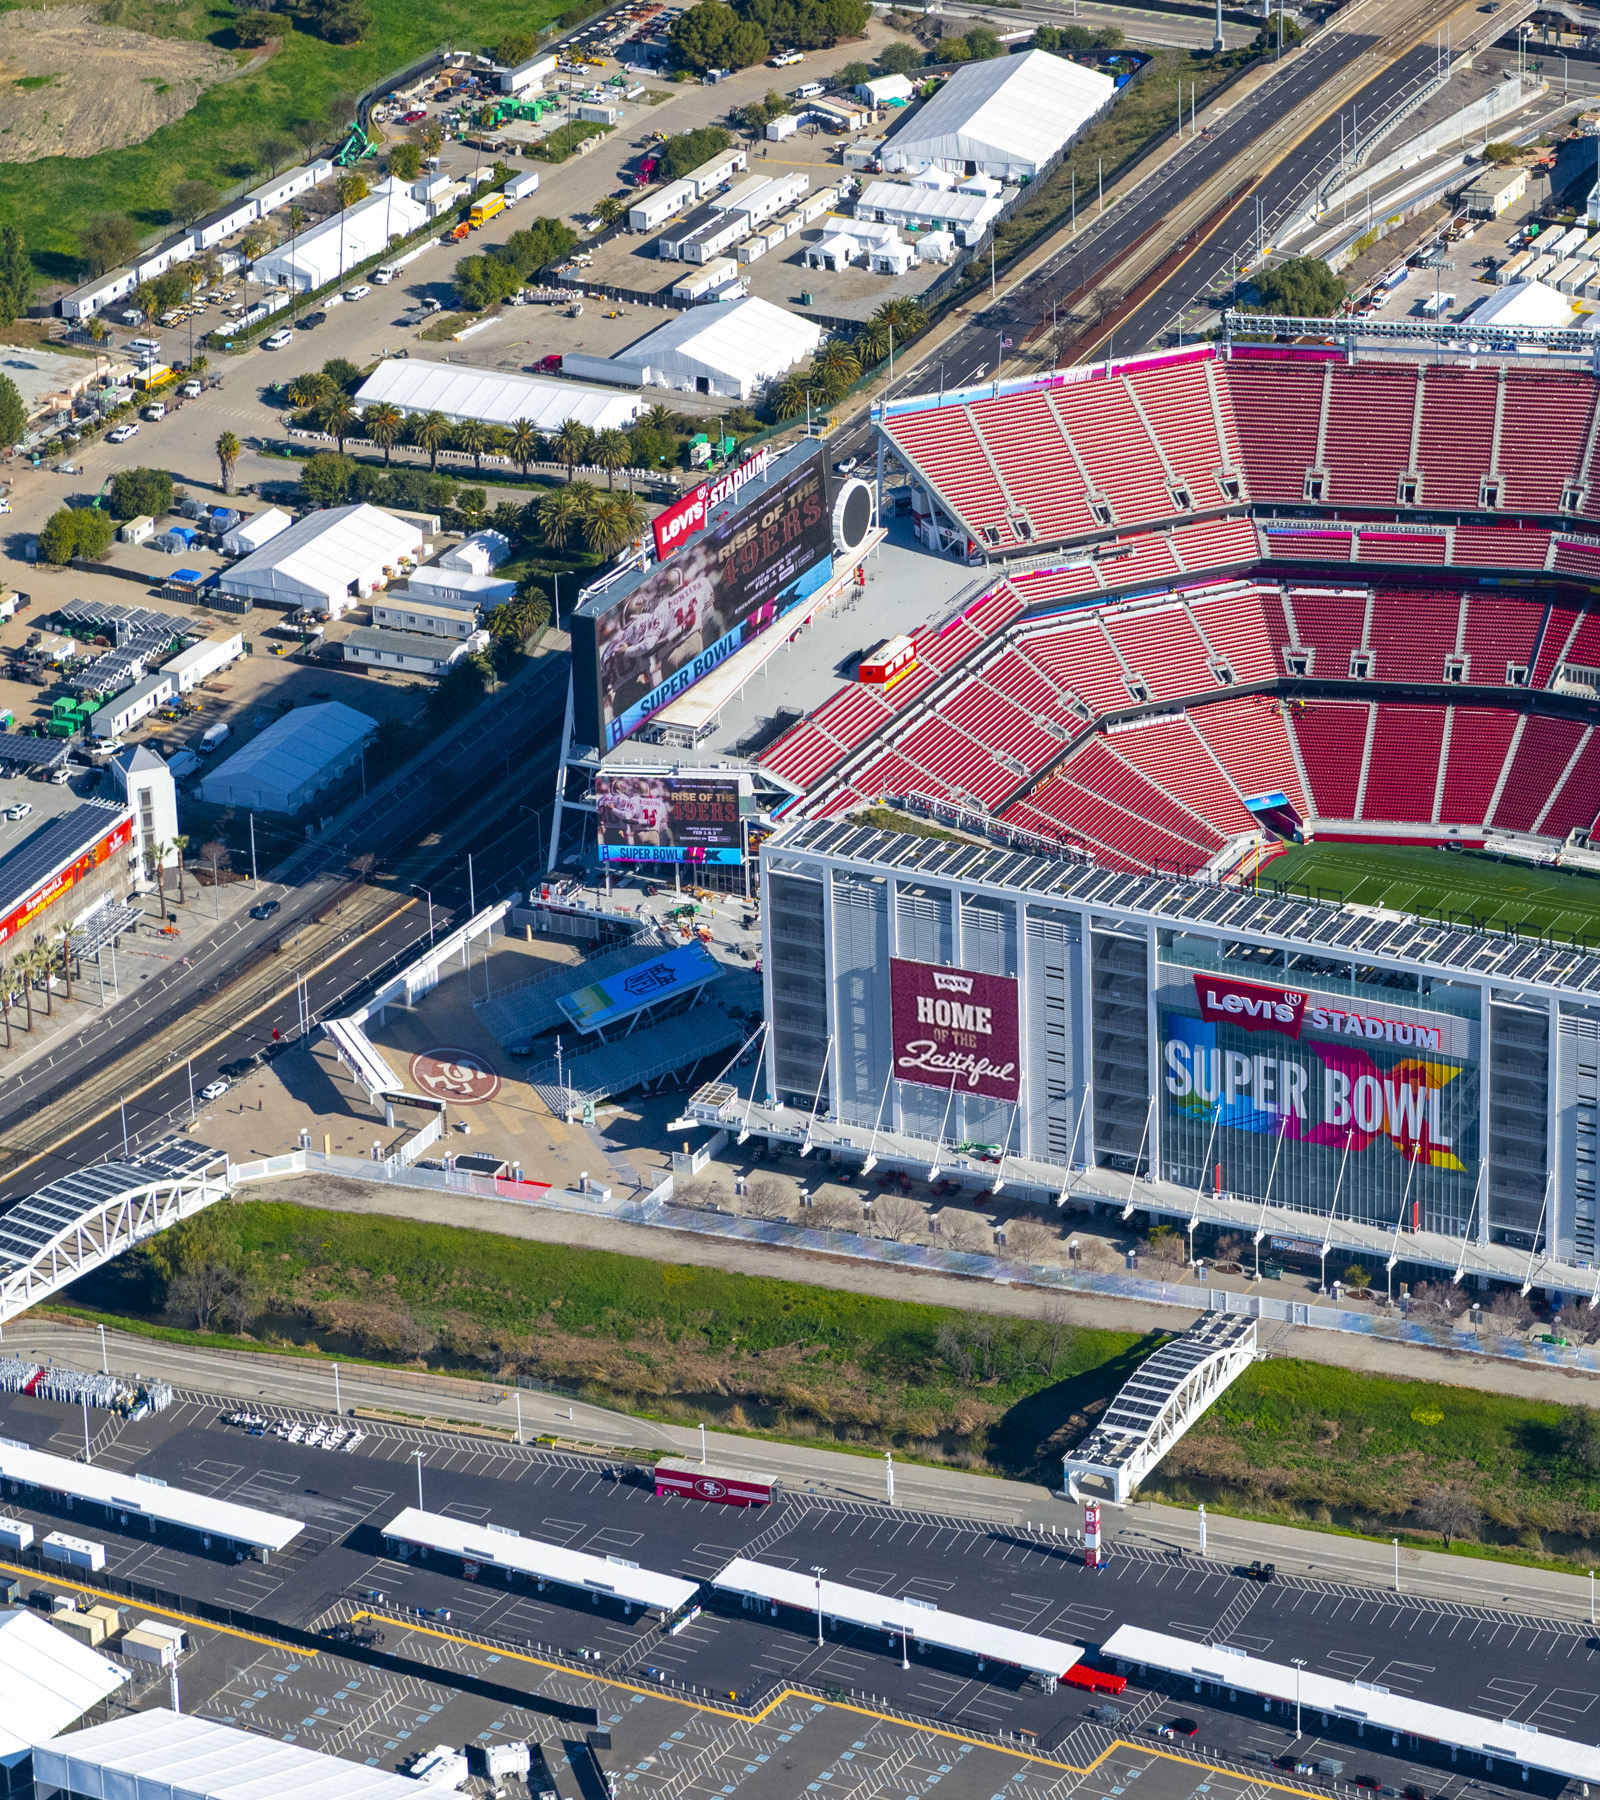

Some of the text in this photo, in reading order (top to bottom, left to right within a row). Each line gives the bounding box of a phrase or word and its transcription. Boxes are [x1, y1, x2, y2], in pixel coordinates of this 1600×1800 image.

[710, 450, 767, 507] STADIUM
[718, 476, 820, 563] RISE OF THE
[719, 493, 822, 588] 49ERS
[640, 669, 690, 718] SUPER
[693, 634, 738, 683] BOWL
[671, 792, 736, 803] RISE OF THE
[671, 801, 736, 823] 49ERS
[620, 847, 651, 860] SUPER
[653, 848, 680, 861] BOWL
[25, 892, 43, 912] Super
[17, 904, 39, 929] Powered
[917, 996, 993, 1035] HOME
[933, 1028, 977, 1048] OF THE
[1312, 1009, 1441, 1050] STADIUM
[1164, 1039, 1453, 1146] SUPER BOWL
[703, 1481, 720, 1495] SF
[1085, 1510, 1095, 1522] B
